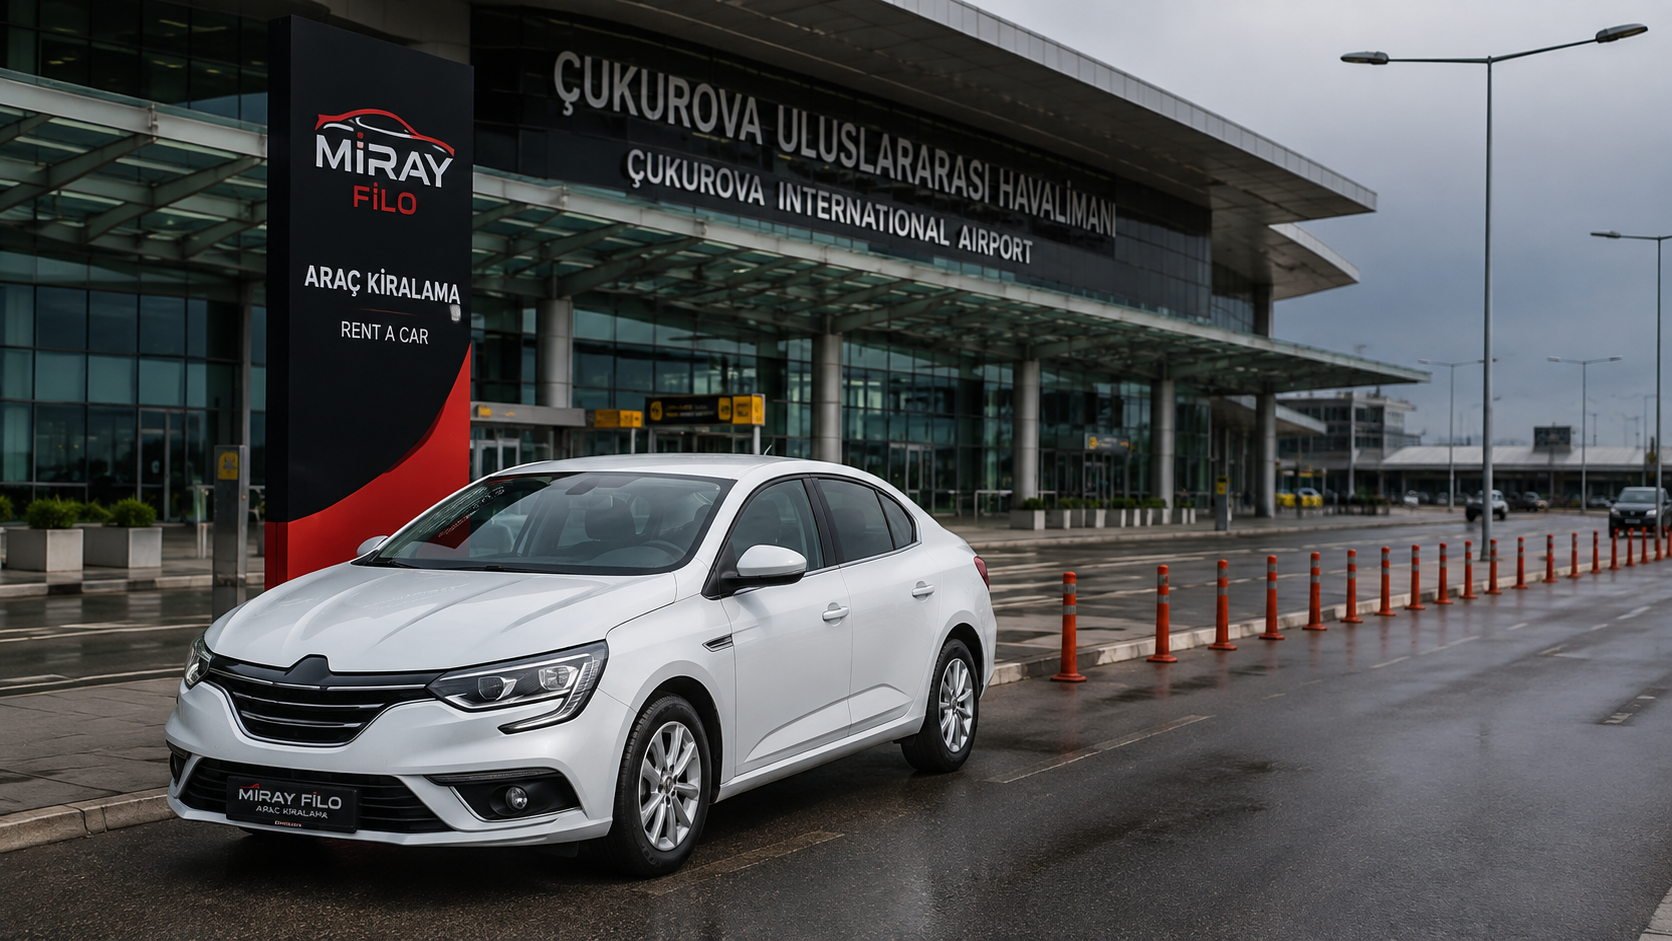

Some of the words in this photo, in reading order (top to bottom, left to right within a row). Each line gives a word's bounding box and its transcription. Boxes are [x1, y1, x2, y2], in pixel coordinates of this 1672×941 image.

[554, 51, 763, 145] ÇUKUROVA
[777, 104, 990, 204] ULUSLARARASI
[999, 167, 1117, 239] HAVALİMANI
[353, 182, 417, 215] FİLO
[627, 149, 765, 207] ÇUKUROVA
[778, 181, 950, 247] INTERNATIONAL
[958, 225, 1033, 265] AIRPORT
[304, 265, 361, 297] ARAÇ
[367, 268, 461, 305] KİRALAMA
[341, 321, 381, 340] RENT
[384, 325, 396, 342] A
[399, 327, 429, 345] CAR
[301, 791, 342, 810] FİLO
